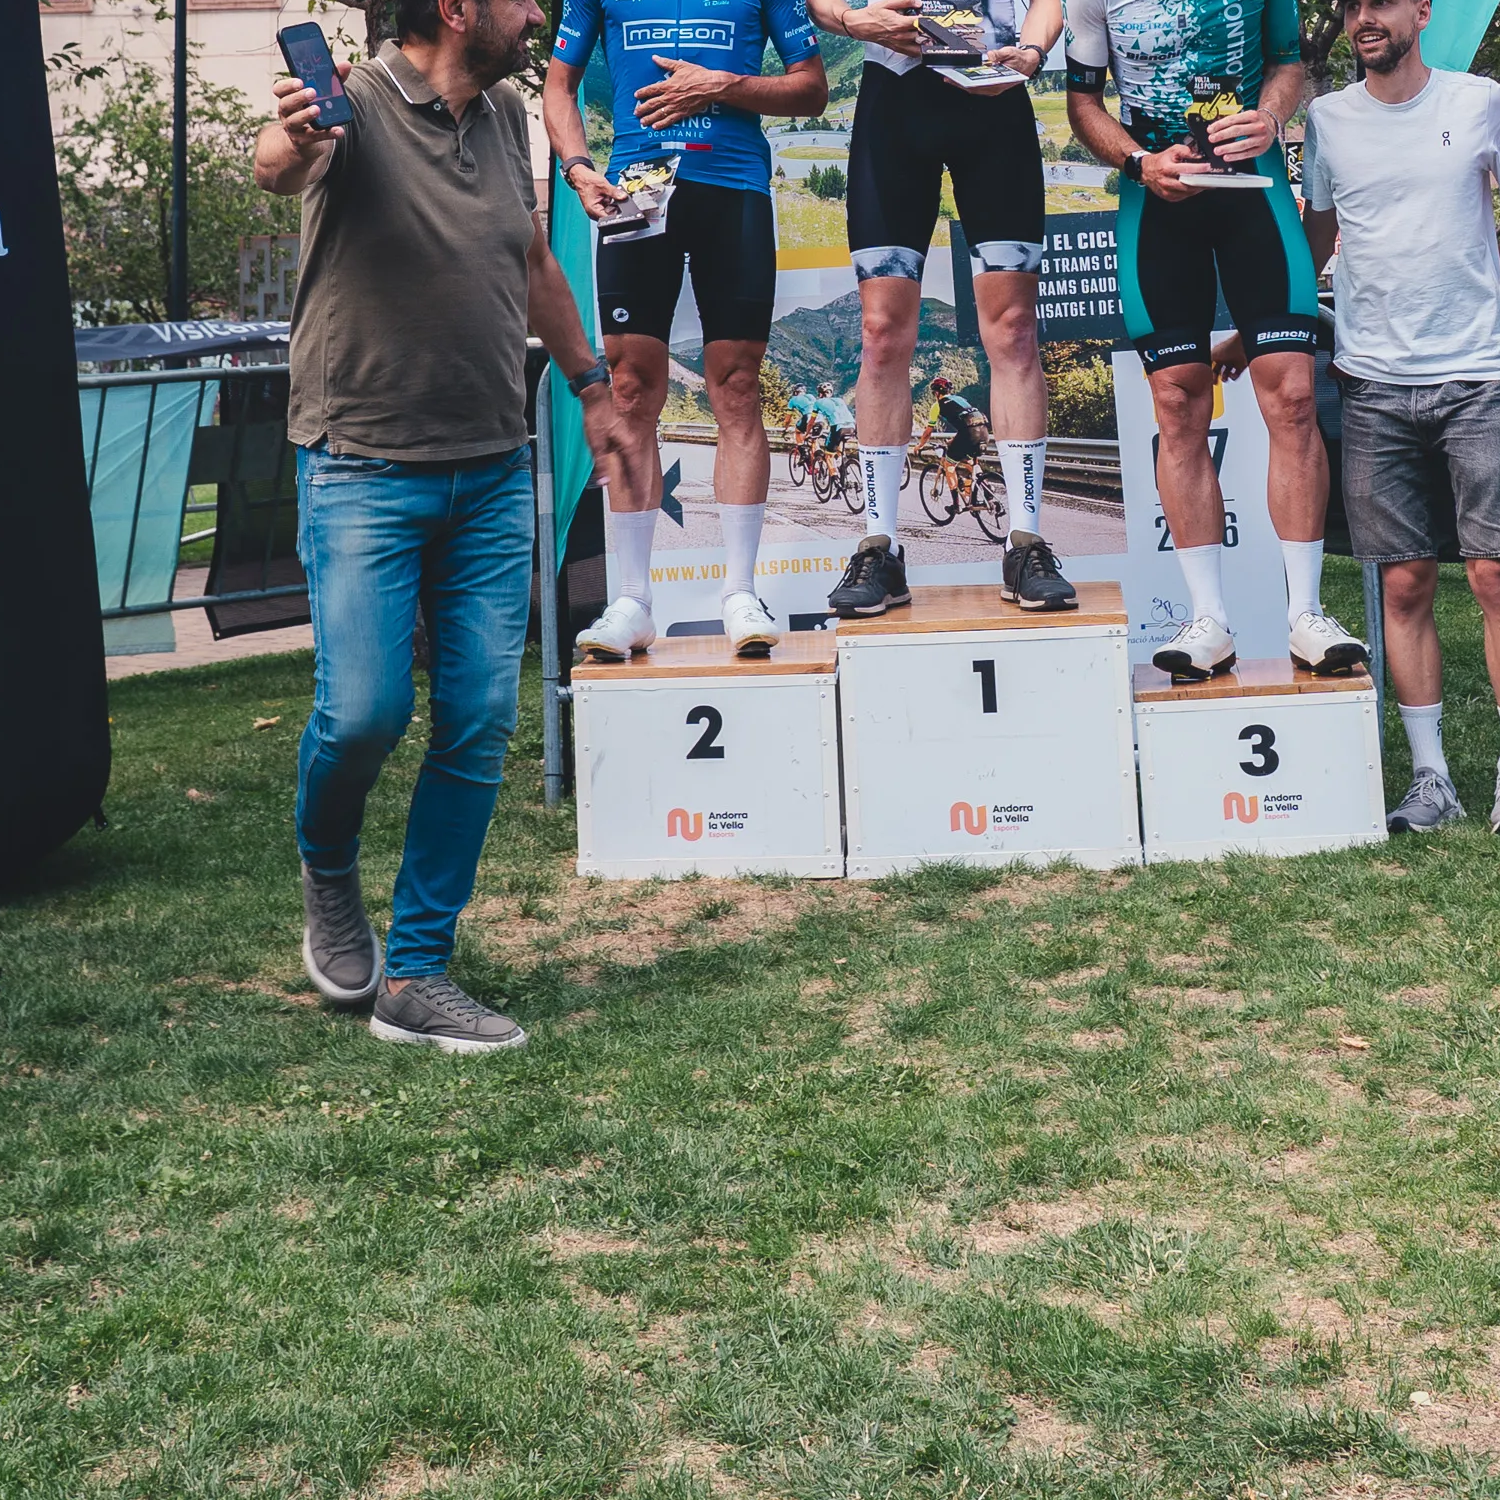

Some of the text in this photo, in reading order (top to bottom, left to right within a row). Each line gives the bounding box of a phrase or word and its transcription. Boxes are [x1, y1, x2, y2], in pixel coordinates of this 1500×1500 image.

[629, 24, 727, 41] marson
[1053, 233, 1073, 250] EL
[1053, 256, 1100, 274] TRAMS
[1081, 276, 1120, 294] GAUD
[1099, 299, 1116, 315] DE
[1257, 329, 1310, 342] Bianchi
[1025, 441, 1045, 449] RYSEL
[866, 460, 877, 508] DECATHLON
[1023, 453, 1035, 501] DECATHLON
[1155, 512, 1239, 552] 26
[972, 660, 998, 714] 1
[686, 705, 725, 759] 2
[1238, 724, 1280, 777] 3
[1263, 794, 1303, 803] Andorra
[708, 812, 748, 820] Andorra
[993, 805, 1034, 813] Andorra
[1264, 803, 1299, 812] la Vella
[708, 821, 744, 830] la Vella
[993, 814, 1030, 823] la Vella
